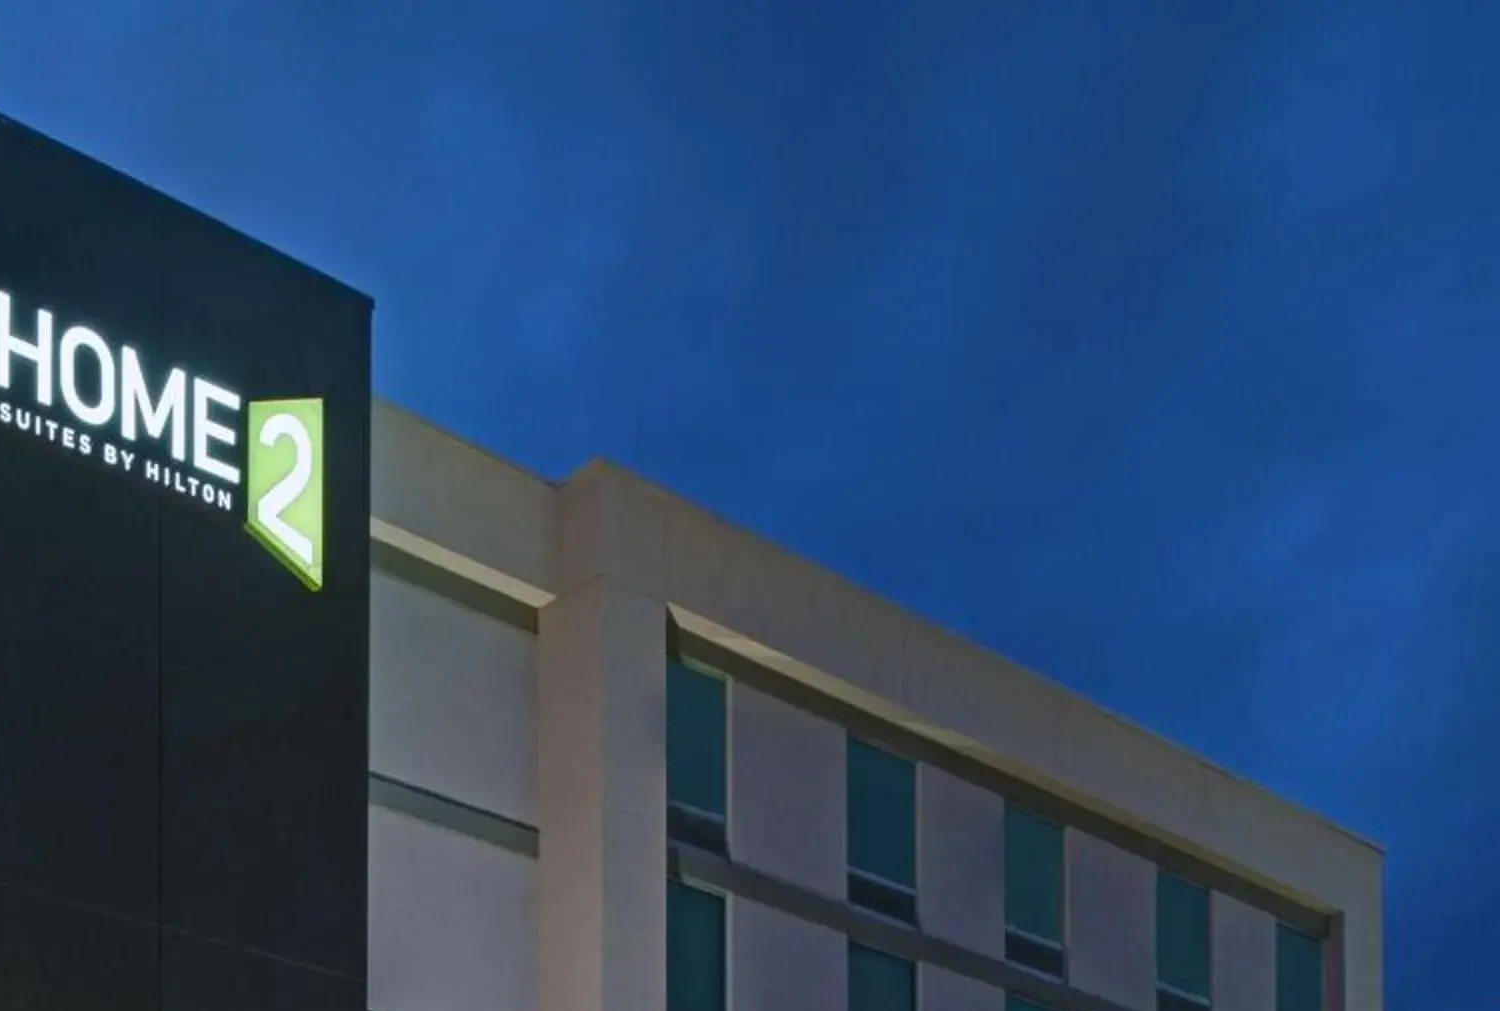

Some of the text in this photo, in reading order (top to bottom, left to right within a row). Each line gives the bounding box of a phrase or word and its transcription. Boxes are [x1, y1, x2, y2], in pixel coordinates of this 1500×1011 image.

[103, 443, 135, 471] BY
[145, 460, 232, 511] HILTON
[258, 412, 314, 565] 2
